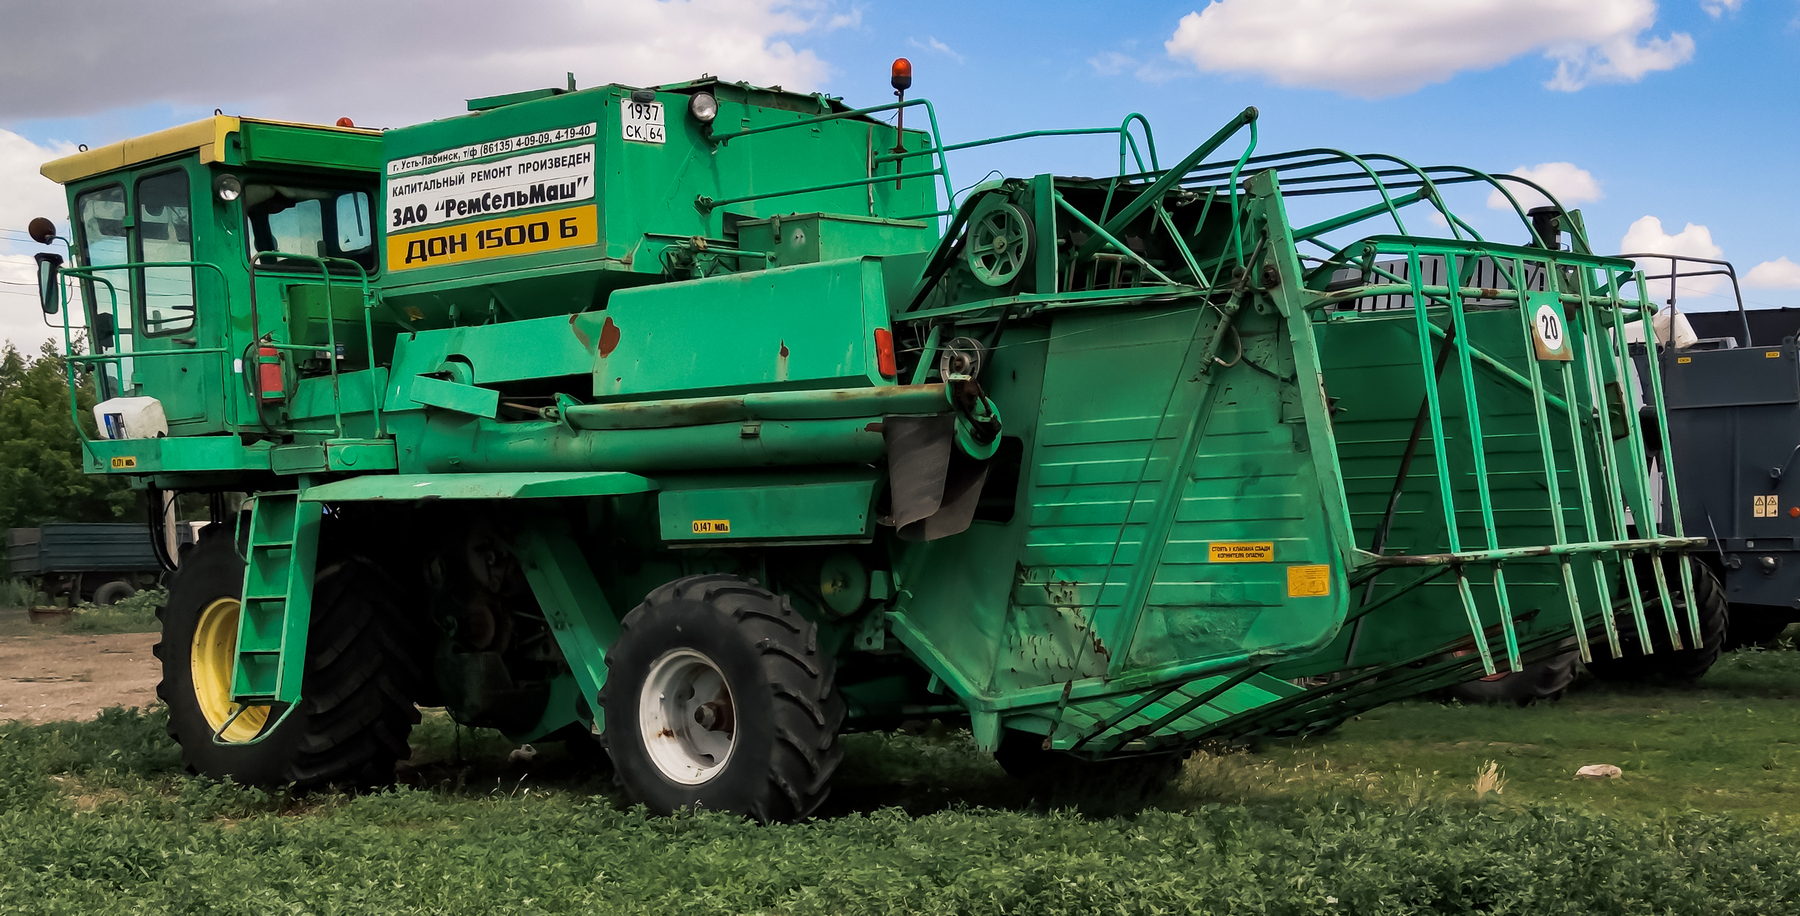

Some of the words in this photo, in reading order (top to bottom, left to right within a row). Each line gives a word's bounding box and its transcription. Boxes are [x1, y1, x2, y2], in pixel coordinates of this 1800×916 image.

[627, 103, 659, 120] 1937
[650, 127, 662, 140] 64
[401, 151, 461, 170] Усть-Лабинск,
[463, 146, 478, 158] т/ф
[480, 140, 513, 156] (86135)
[516, 132, 553, 148] 4-09-09,
[555, 125, 591, 140] 4-19-40
[392, 171, 465, 197] КАПИТАЛЬНЫЙ
[471, 165, 513, 183] РЕМОНТ
[518, 151, 591, 174] ПРОИЗВЕДЕН
[392, 203, 428, 227] ЗАО
[405, 232, 468, 264] ДОН
[475, 221, 549, 250] 1500
[559, 217, 578, 239] Б
[1541, 314, 1559, 340] 20
